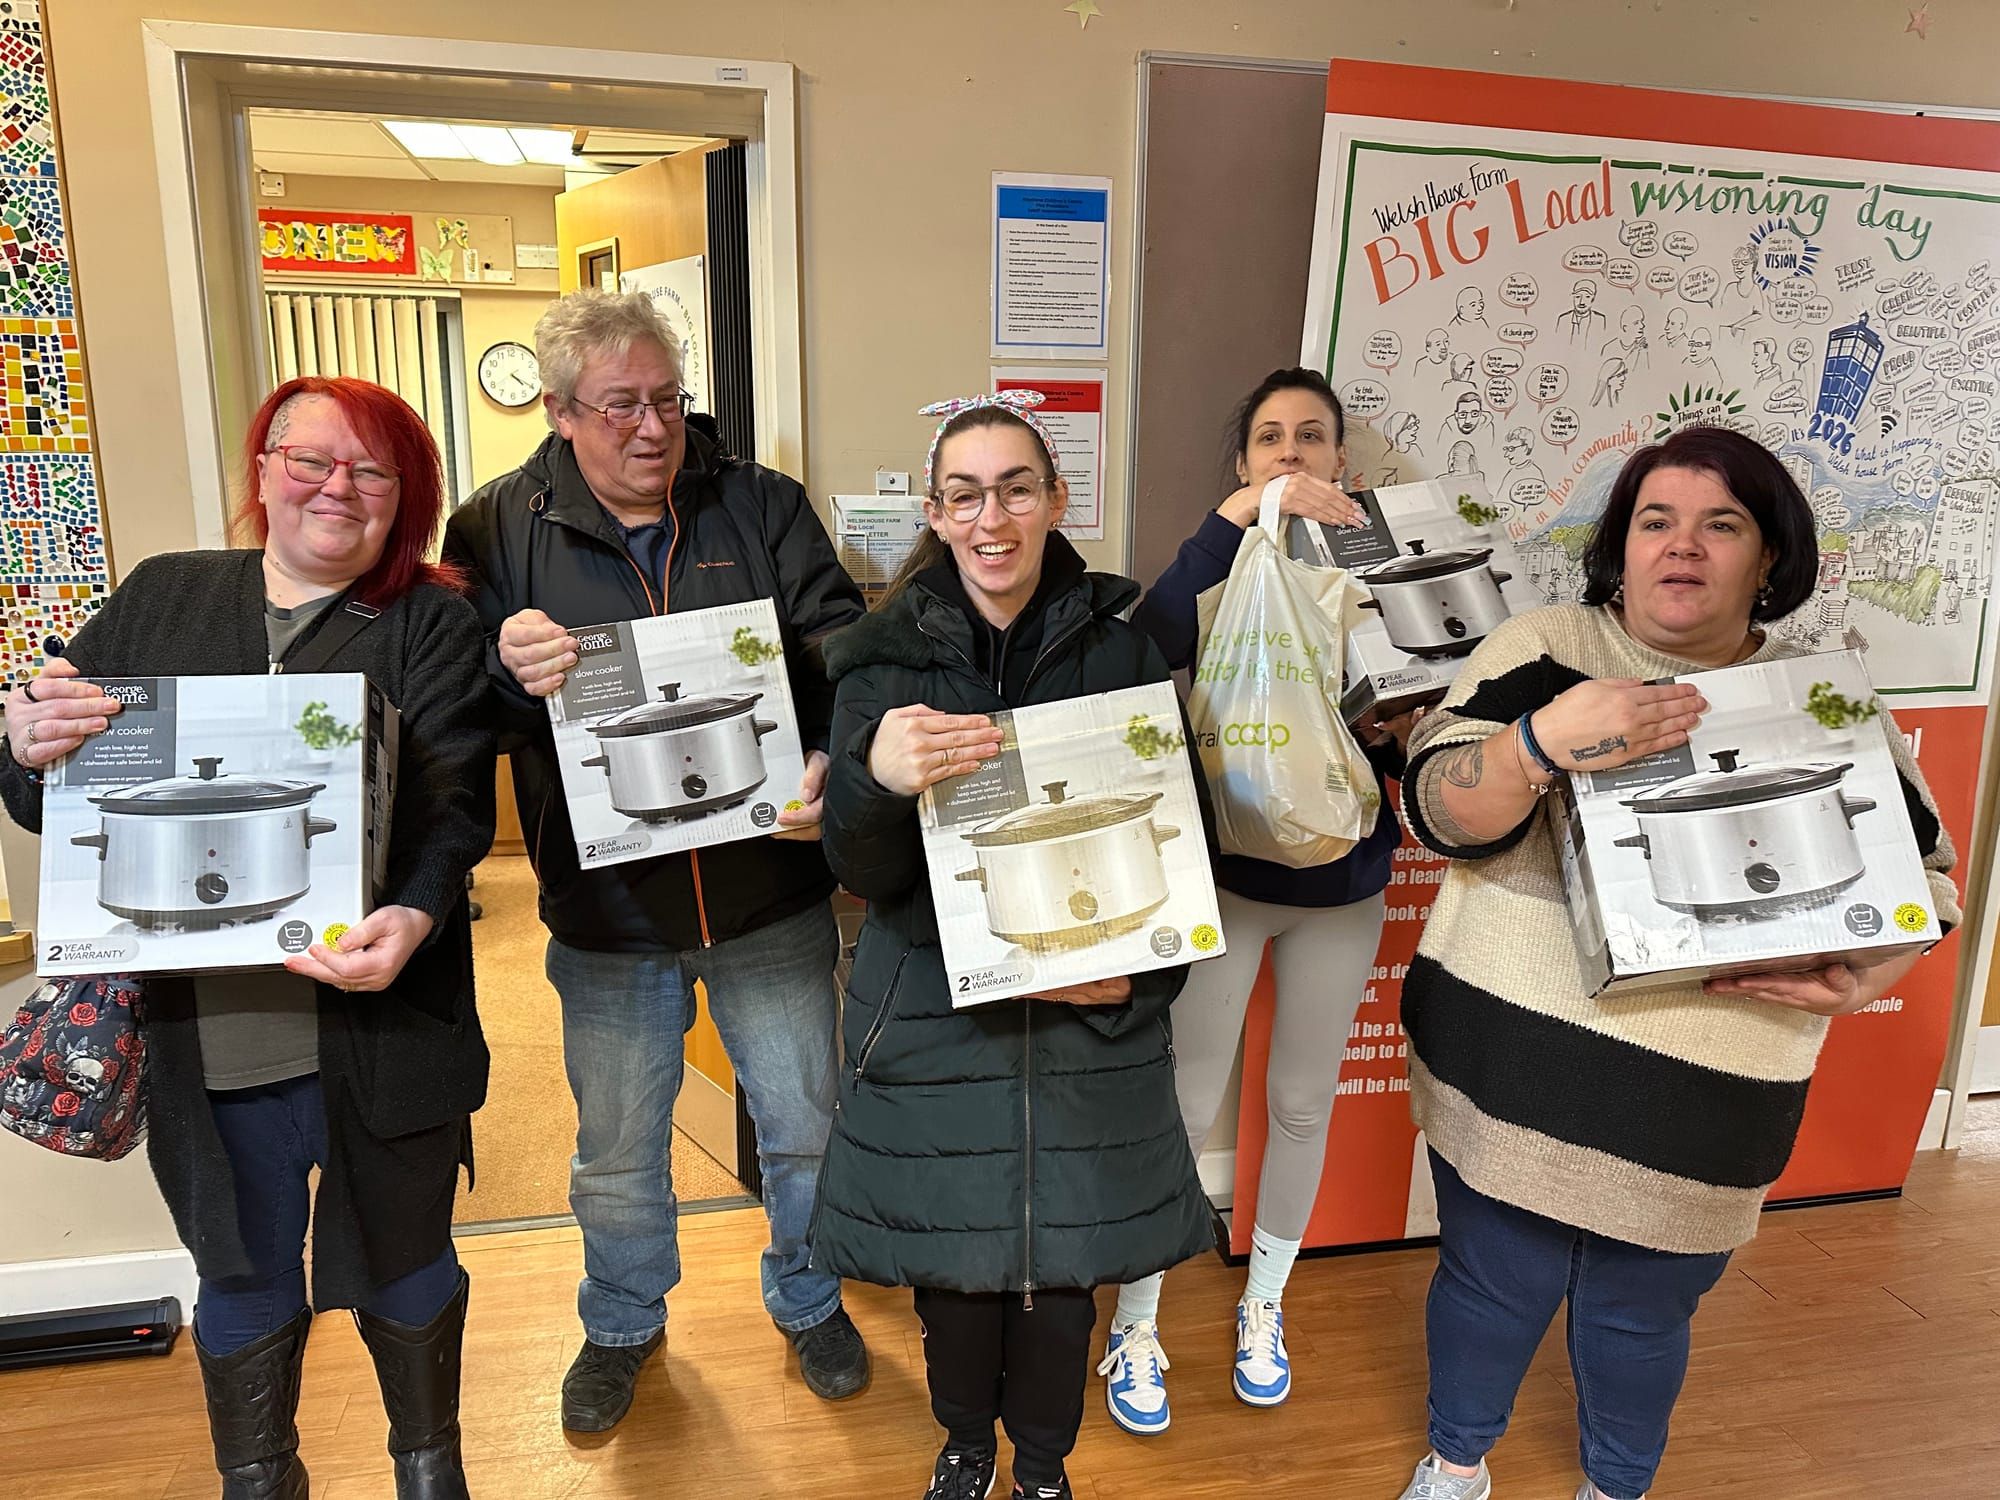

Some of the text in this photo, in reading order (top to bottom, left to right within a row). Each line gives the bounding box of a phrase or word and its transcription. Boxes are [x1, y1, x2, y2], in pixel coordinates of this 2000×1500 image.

[1372, 162, 1508, 234] Welsh House Farm
[1363, 160, 1933, 305] BIG Local visioning day
[1765, 253, 1797, 269] VISION
[1835, 255, 1872, 278] TRUST
[664, 287, 680, 306] FARM
[683, 309, 700, 377] BIG LOCAL
[507, 349, 515, 357] 12
[489, 360, 498, 368] 10
[528, 361, 534, 369] 2
[1883, 350, 1916, 376] PROUD
[490, 381, 496, 389] 8
[499, 389, 504, 397] 7
[510, 392, 516, 400] 6
[521, 390, 527, 398] 5
[1676, 404, 1721, 424] Things can
[1791, 428, 1805, 442] It's
[1807, 413, 1856, 456] 2026
[1854, 444, 1876, 461] What
[1892, 438, 1933, 454] happening
[1548, 474, 1575, 507] this
[1572, 414, 1653, 475] community?
[1827, 452, 1849, 475] Welsh
[1965, 504, 1984, 514] Estate
[575, 665, 623, 679] slow cooker
[1276, 660, 1314, 684] the
[1377, 673, 1402, 689] 2 YEAR
[1387, 675, 1424, 687] WARRANTY
[117, 725, 154, 736] cooker
[585, 840, 617, 858] 2 YEAR
[598, 842, 642, 856] WARRANTY
[1384, 905, 1417, 920] look
[47, 943, 92, 962] 2 YEAR
[64, 949, 125, 961] WARRANTY
[958, 970, 994, 992] 2 YEAR
[972, 973, 1023, 990] WARRANTY
[1362, 1022, 1382, 1038] be
[1385, 1023, 1395, 1037] a
[1342, 1044, 1394, 1061] help to
[1335, 1079, 1363, 1095] will
[1365, 1078, 1386, 1094] be
